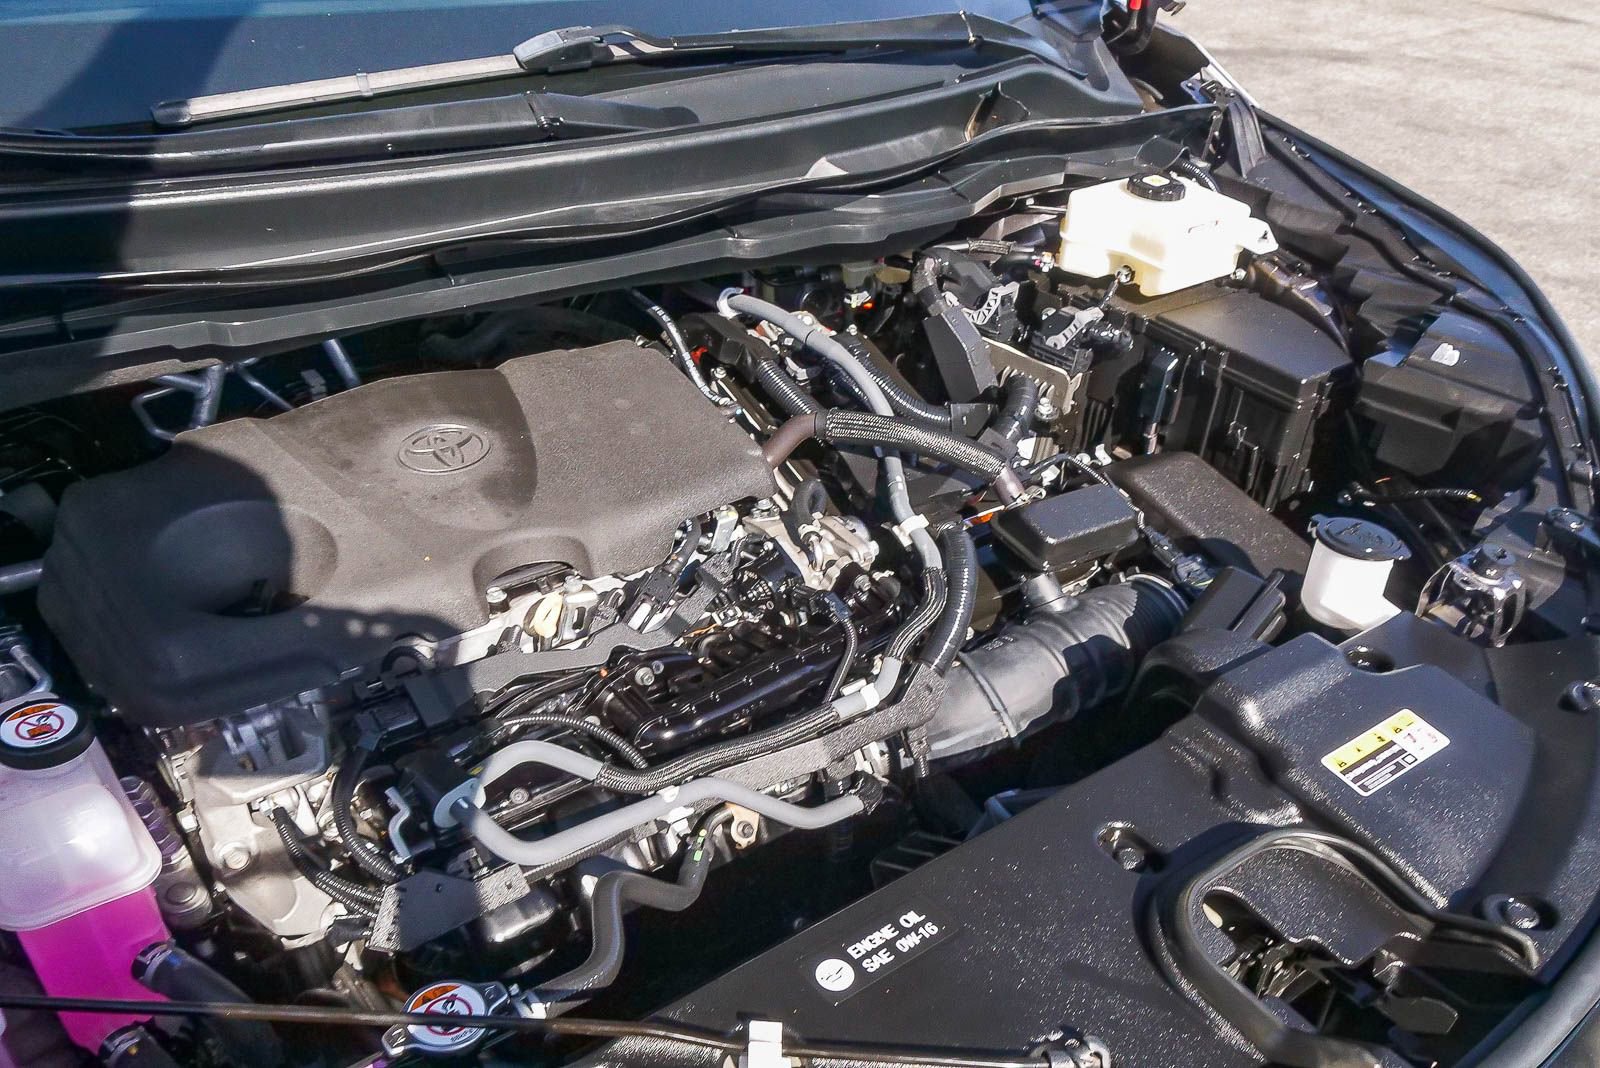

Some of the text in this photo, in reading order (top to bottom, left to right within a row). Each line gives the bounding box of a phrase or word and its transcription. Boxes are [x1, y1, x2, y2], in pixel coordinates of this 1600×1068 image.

[847, 911, 926, 959] ENGINE OIL
[862, 922, 938, 972] SAE 0W-16
